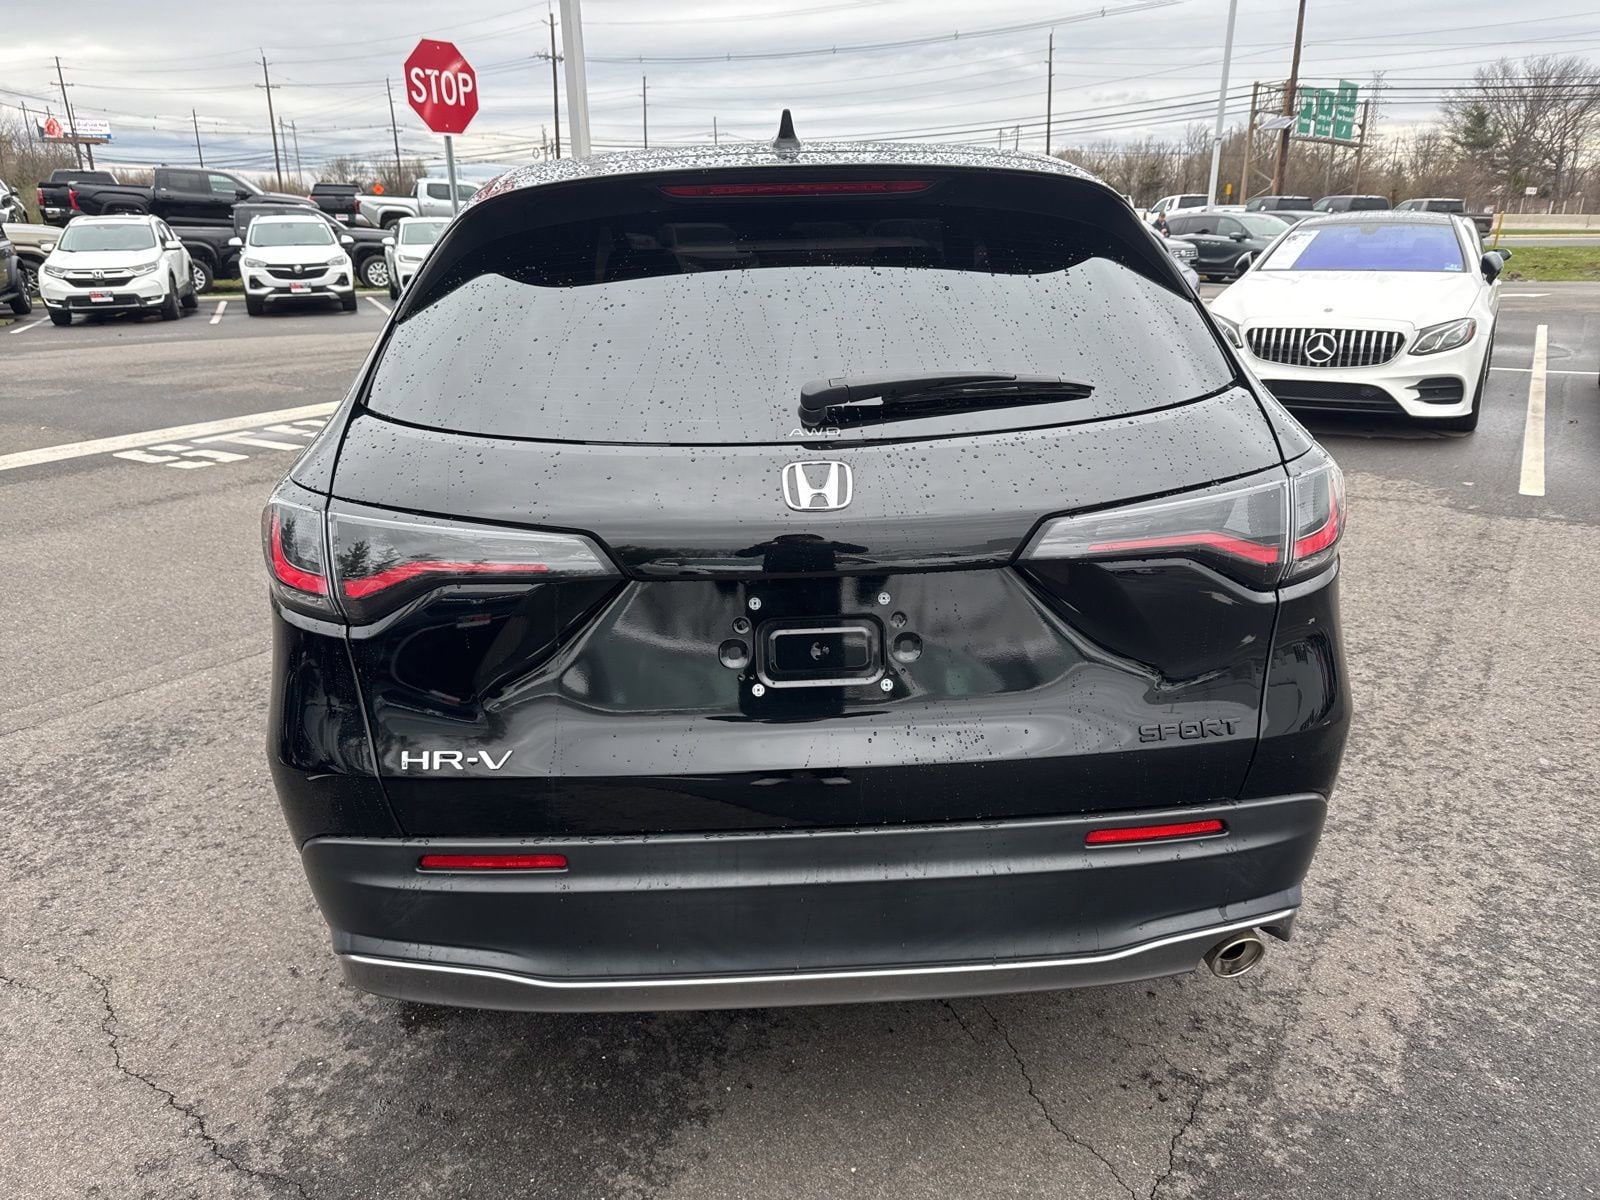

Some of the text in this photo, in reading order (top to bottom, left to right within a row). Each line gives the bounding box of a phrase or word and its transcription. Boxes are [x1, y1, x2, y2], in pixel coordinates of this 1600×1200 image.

[410, 67, 473, 107] STOP
[789, 427, 841, 437] AWD
[1138, 717, 1241, 743] SPORT
[401, 750, 513, 770] HR-V
